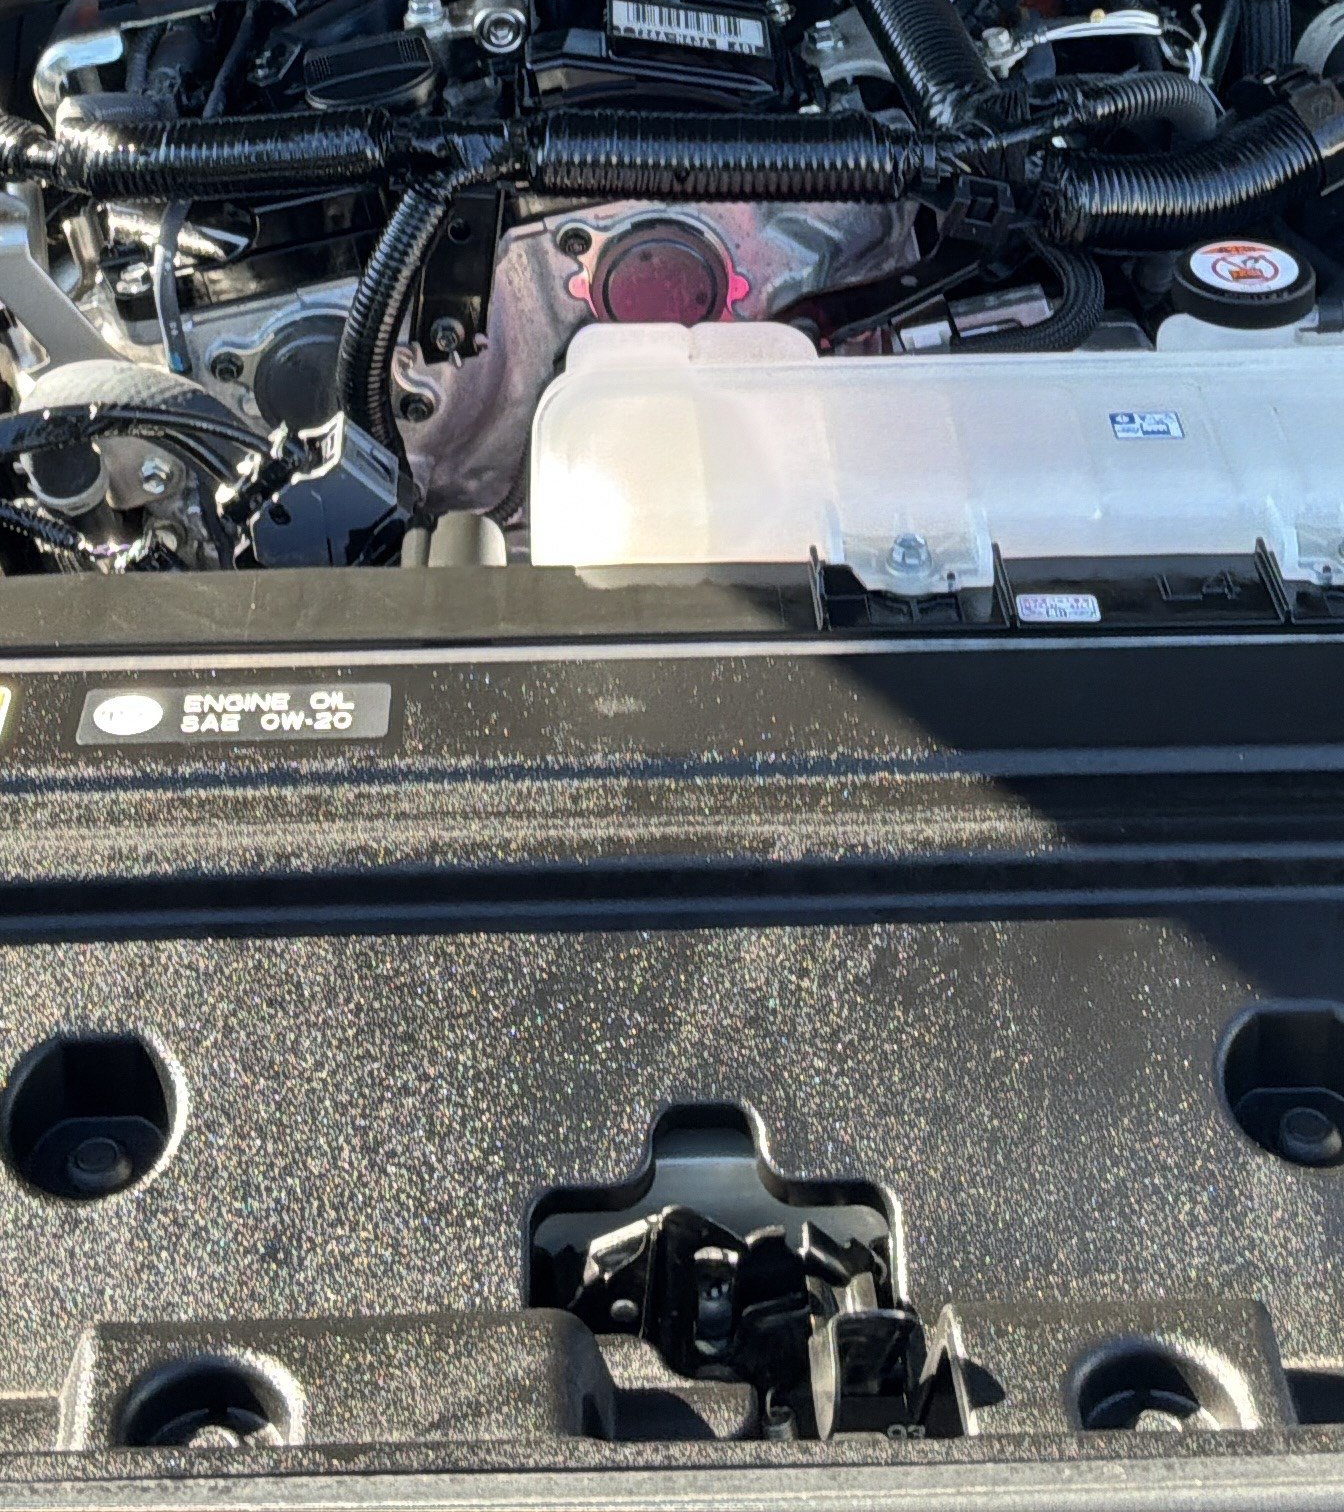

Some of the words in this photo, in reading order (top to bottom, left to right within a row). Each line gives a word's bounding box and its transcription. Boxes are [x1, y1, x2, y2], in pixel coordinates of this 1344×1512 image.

[183, 692, 292, 713] ENGINE
[309, 691, 355, 711] OIL
[180, 713, 242, 733] SAE
[260, 711, 354, 731] 0W-20
